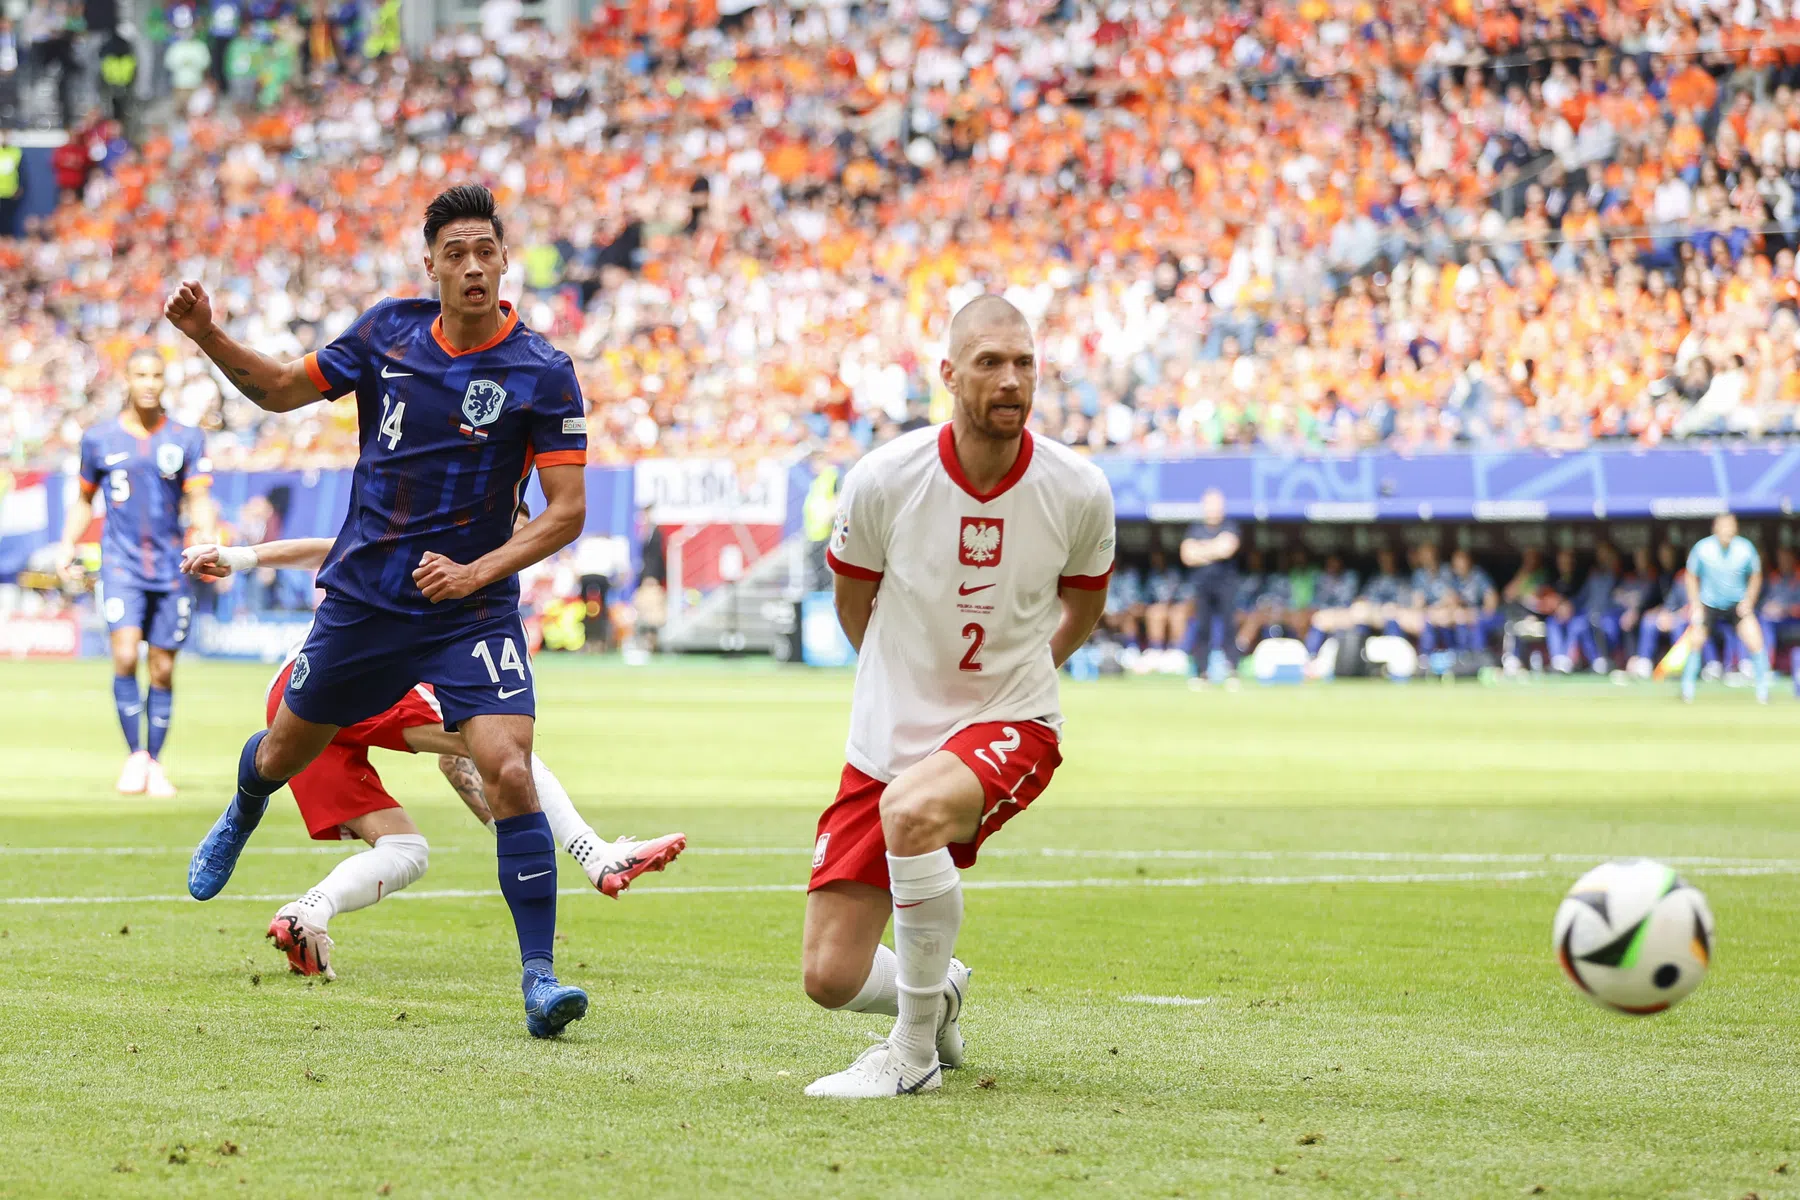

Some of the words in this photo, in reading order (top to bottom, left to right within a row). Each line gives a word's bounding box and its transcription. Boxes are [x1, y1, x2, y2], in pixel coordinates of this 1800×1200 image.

[377, 392, 406, 451] 14
[110, 468, 131, 502] 5
[471, 637, 526, 684] 14
[959, 622, 986, 672] 2
[989, 726, 1021, 765] 2
